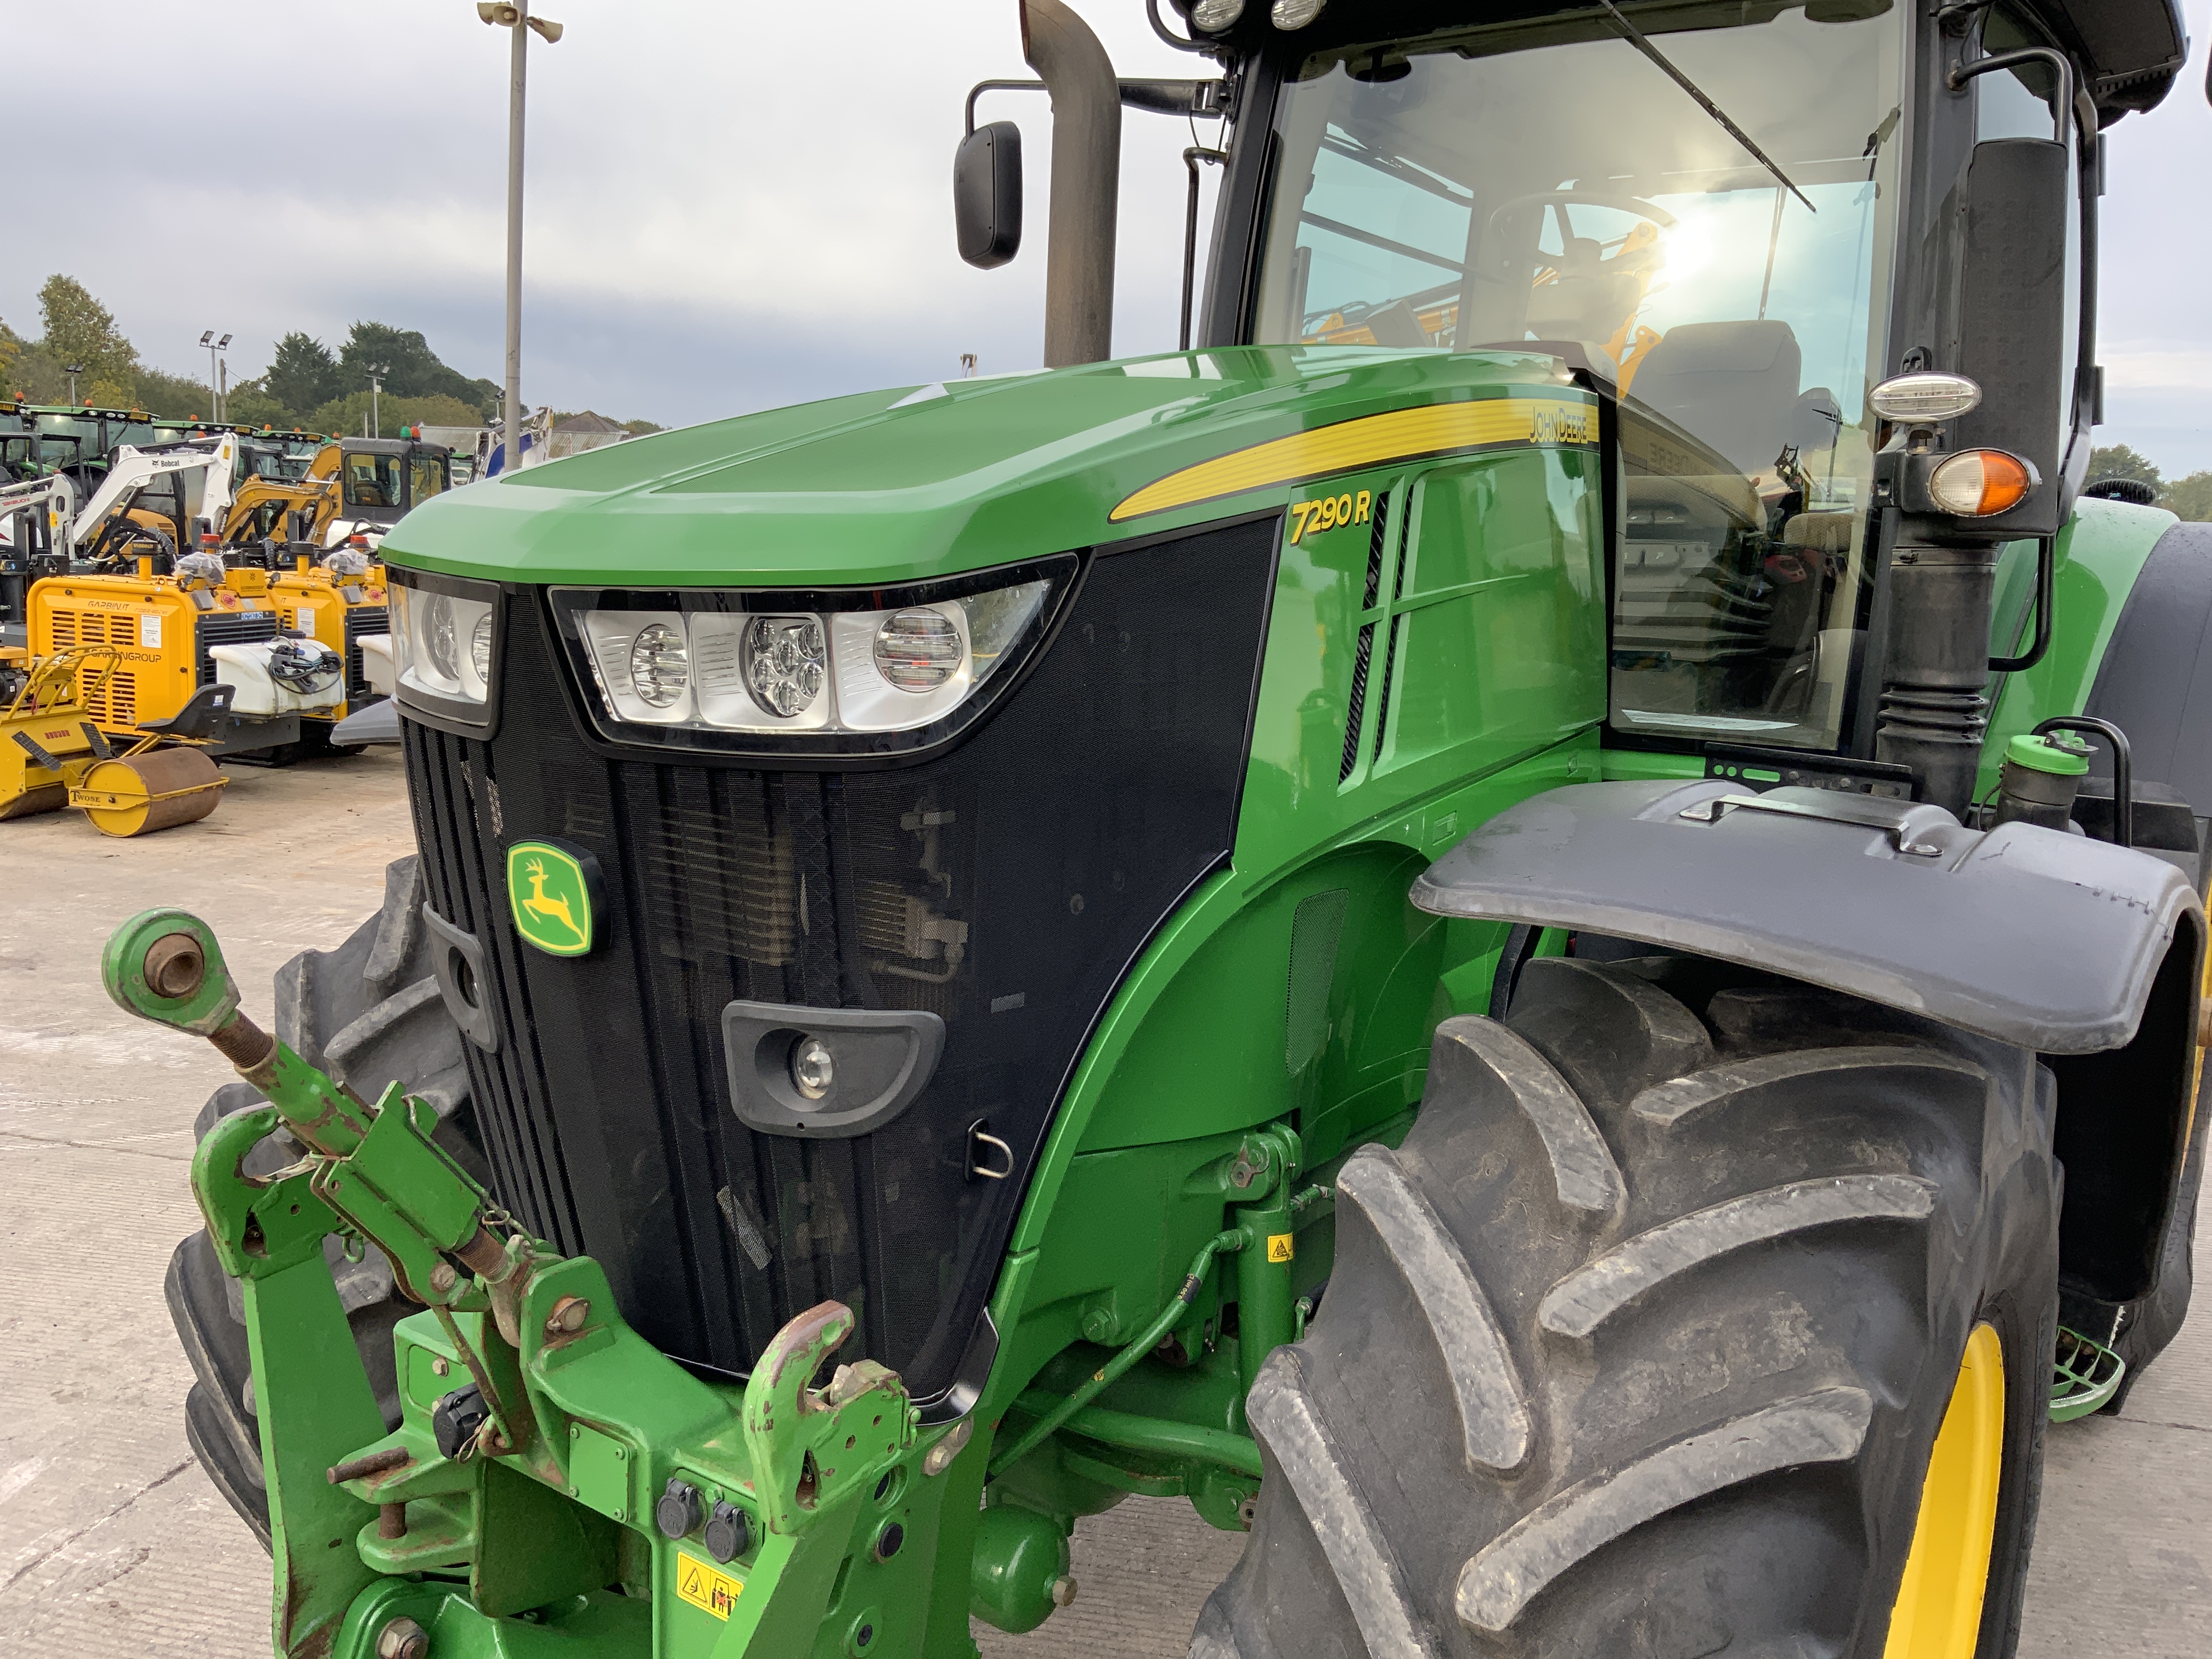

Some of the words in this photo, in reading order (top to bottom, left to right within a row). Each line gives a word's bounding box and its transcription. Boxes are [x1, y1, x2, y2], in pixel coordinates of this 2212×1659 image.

[1530, 406, 1558, 439] JOHN
[1559, 408, 1587, 441] DEERE
[1290, 493, 1353, 548] 7290
[1355, 489, 1371, 527] R
[91, 649, 161, 663] GARNGROUP
